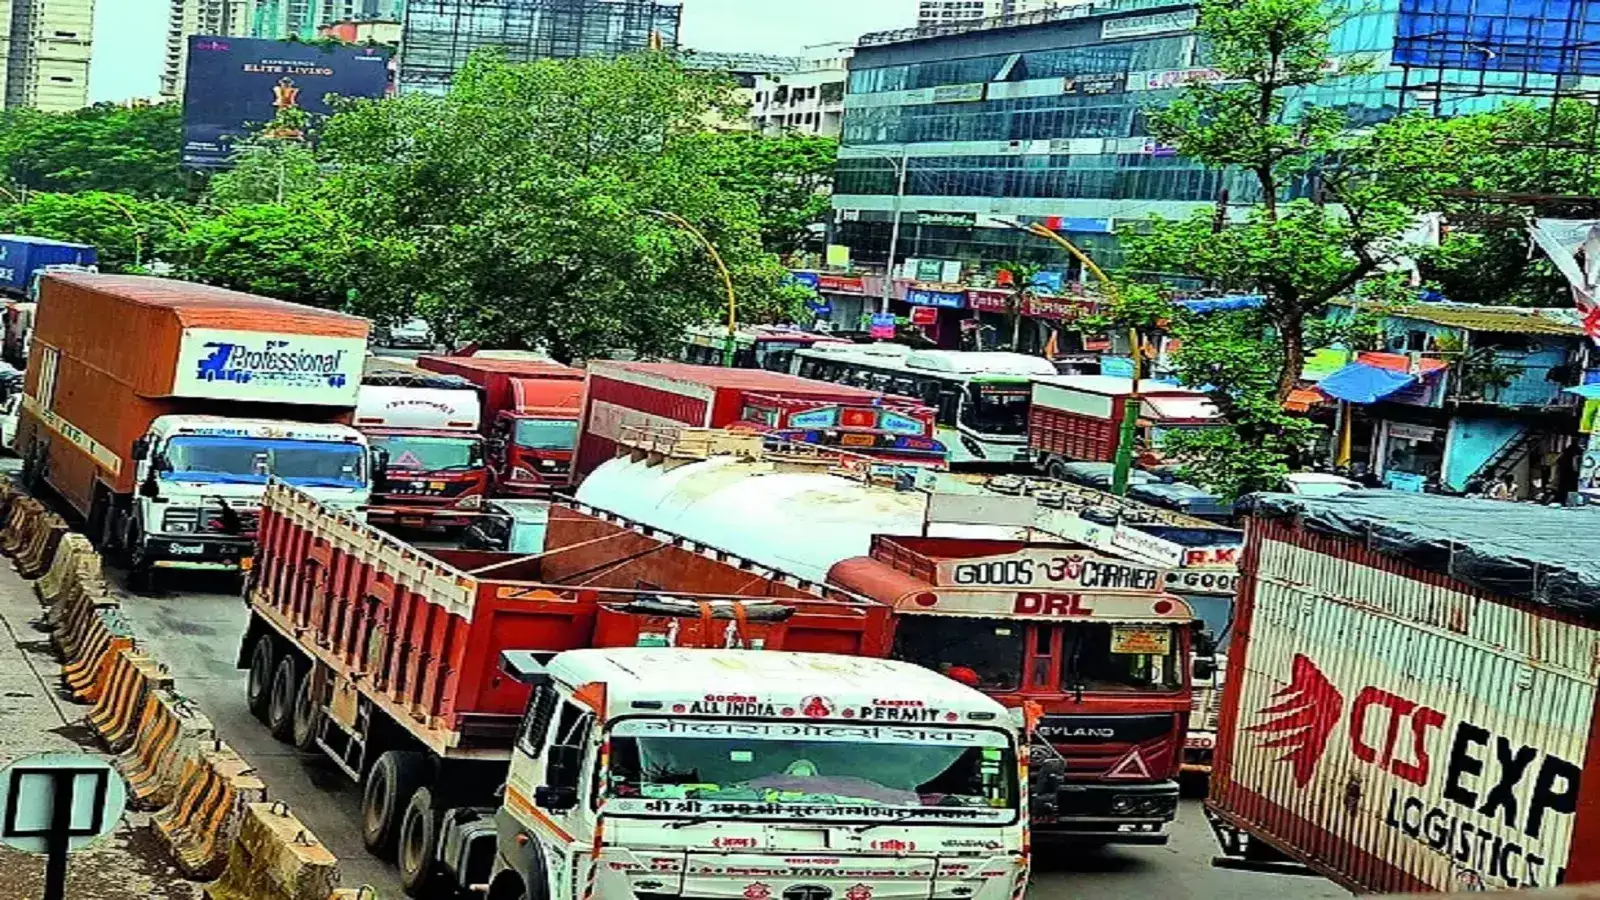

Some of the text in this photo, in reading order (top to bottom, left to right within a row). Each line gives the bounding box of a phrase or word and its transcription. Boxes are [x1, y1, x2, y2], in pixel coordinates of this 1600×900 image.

[244, 63, 334, 76] ELITE LIVING
[229, 345, 343, 373] Professional
[954, 560, 1033, 586] GOODS
[1081, 562, 1158, 590] CARRIER
[1013, 592, 1094, 616] DRL
[690, 701, 940, 722] ALL INDIA PERMIT
[1350, 685, 1583, 839] CTS EXP
[789, 867, 837, 878] TATA
